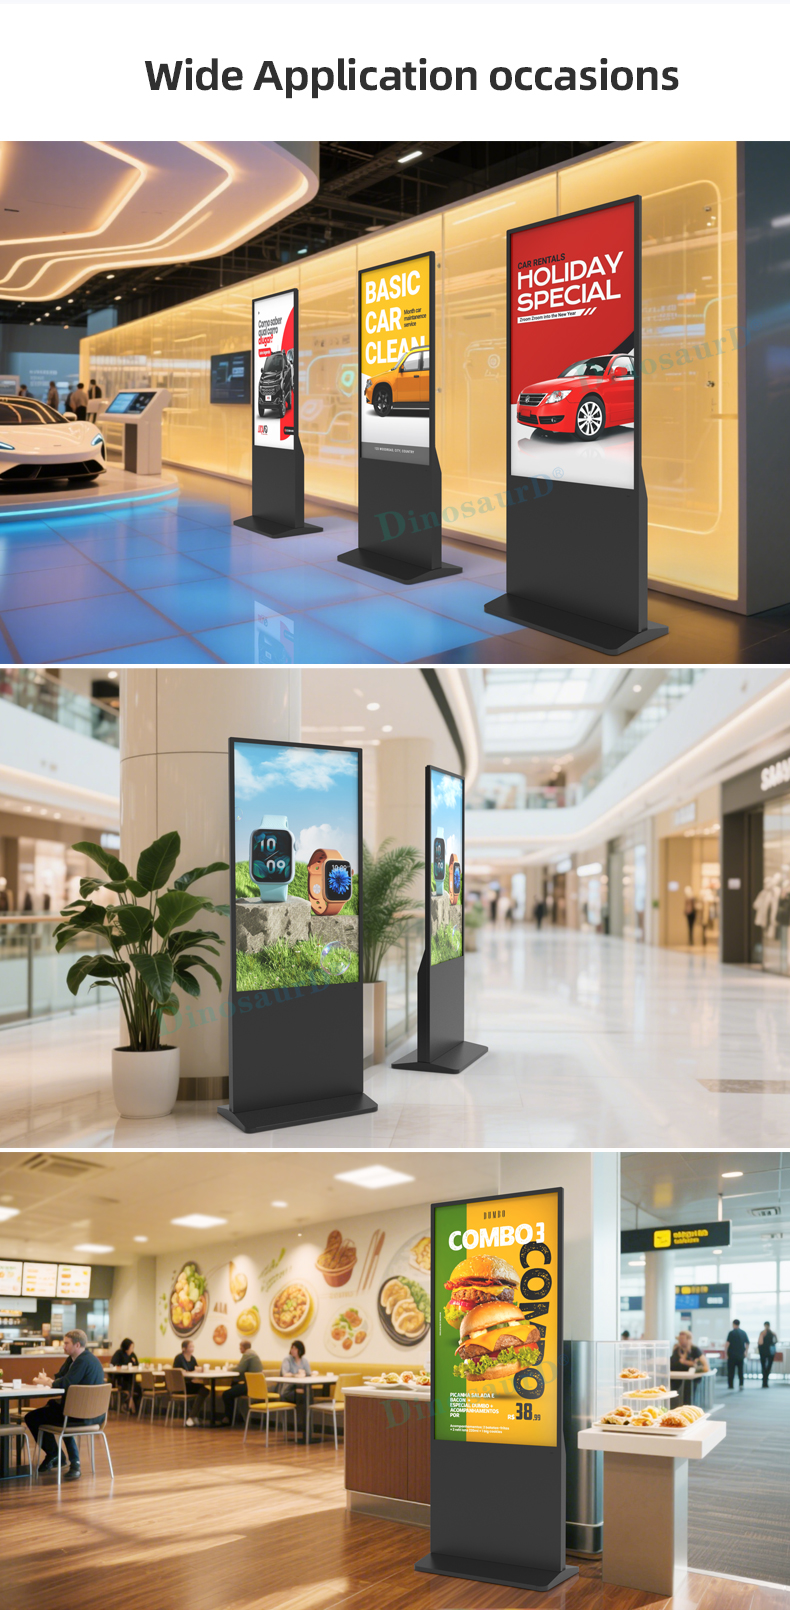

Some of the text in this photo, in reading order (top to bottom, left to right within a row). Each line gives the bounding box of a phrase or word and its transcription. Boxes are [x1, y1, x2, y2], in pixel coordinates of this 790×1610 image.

[517, 253, 566, 270] CAR RENTALS
[517, 251, 624, 290] HOLIDAY
[365, 270, 421, 304] BASIC
[517, 279, 622, 312] SPECIAL
[365, 306, 402, 334] CAR
[261, 838, 276, 852] 10
[483, 1210, 506, 1220] DUMBO
[448, 1222, 545, 1251] COMBO 3
